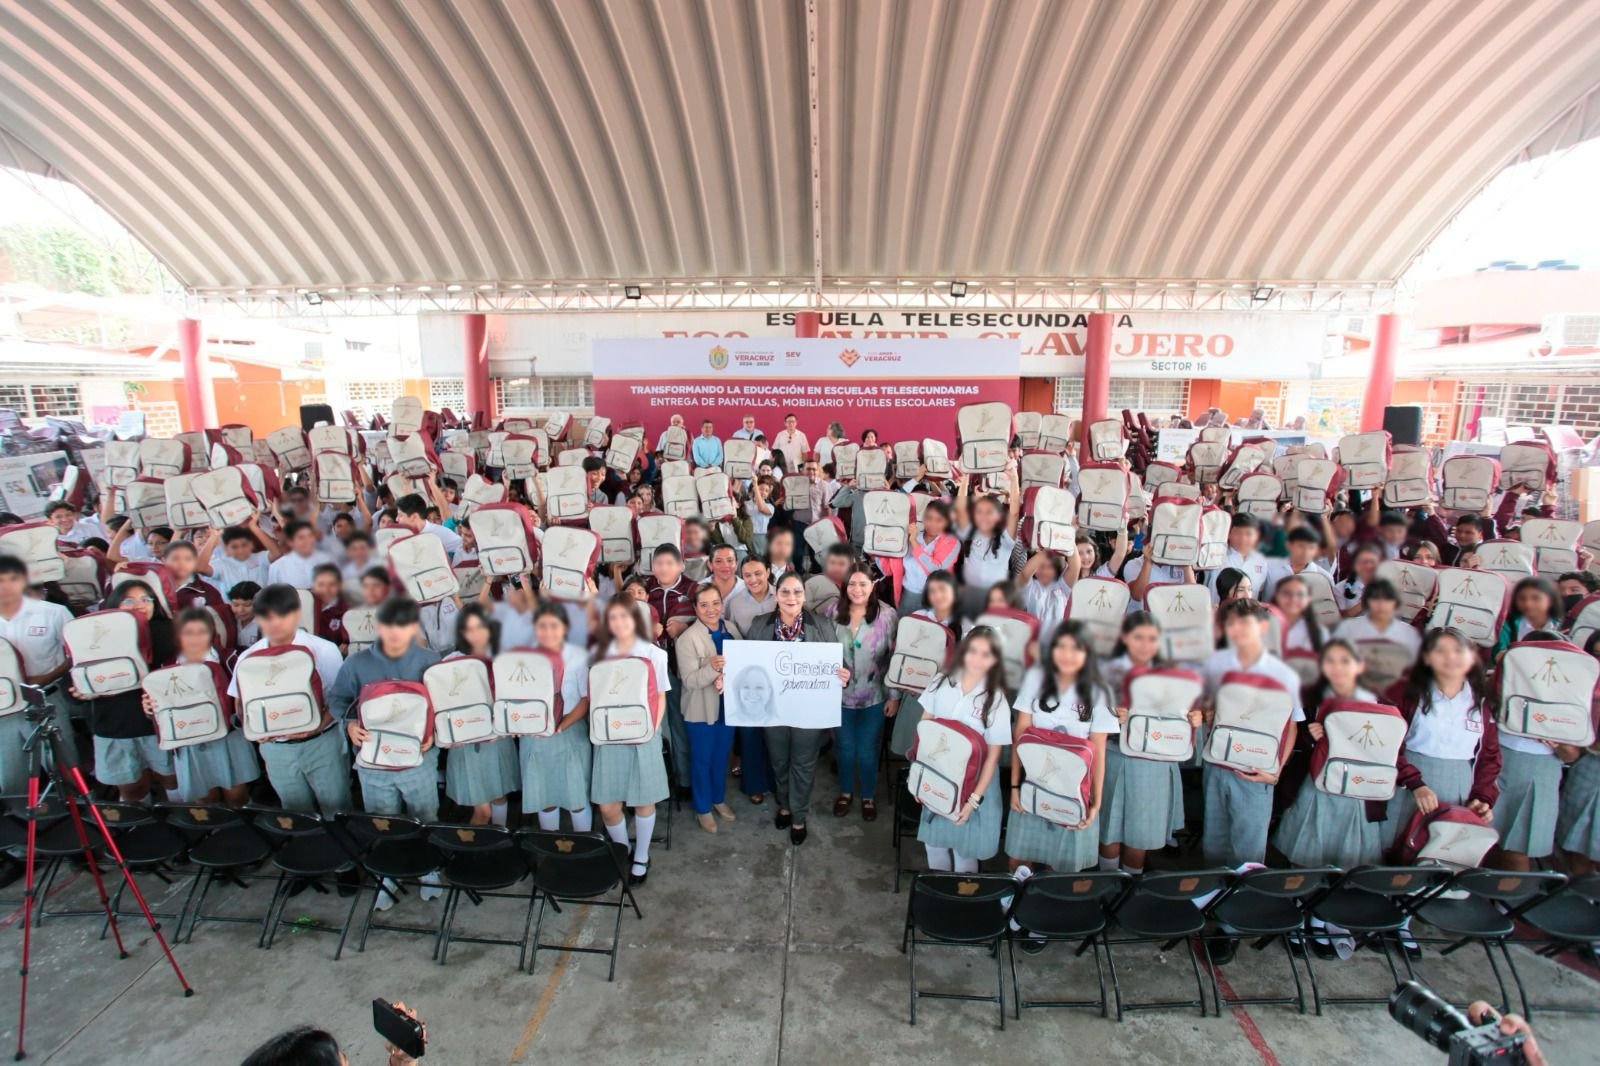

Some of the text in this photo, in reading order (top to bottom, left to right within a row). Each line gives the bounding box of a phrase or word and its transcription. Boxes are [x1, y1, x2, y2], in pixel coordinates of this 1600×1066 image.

[766, 312, 1133, 328] ESUELA TELESECUNDAA
[1151, 361, 1207, 371] SECTOR 16
[631, 384, 979, 394] TRANSFORMANDO LA EDUCACIÓN EN ESCUELAS TELESECUNDARIAS
[650, 396, 956, 408] ENTREGA DE PANTALLAS, MOBILIARIO Y ÚTILES ESCOLARES
[775, 650, 841, 676] Gracias
